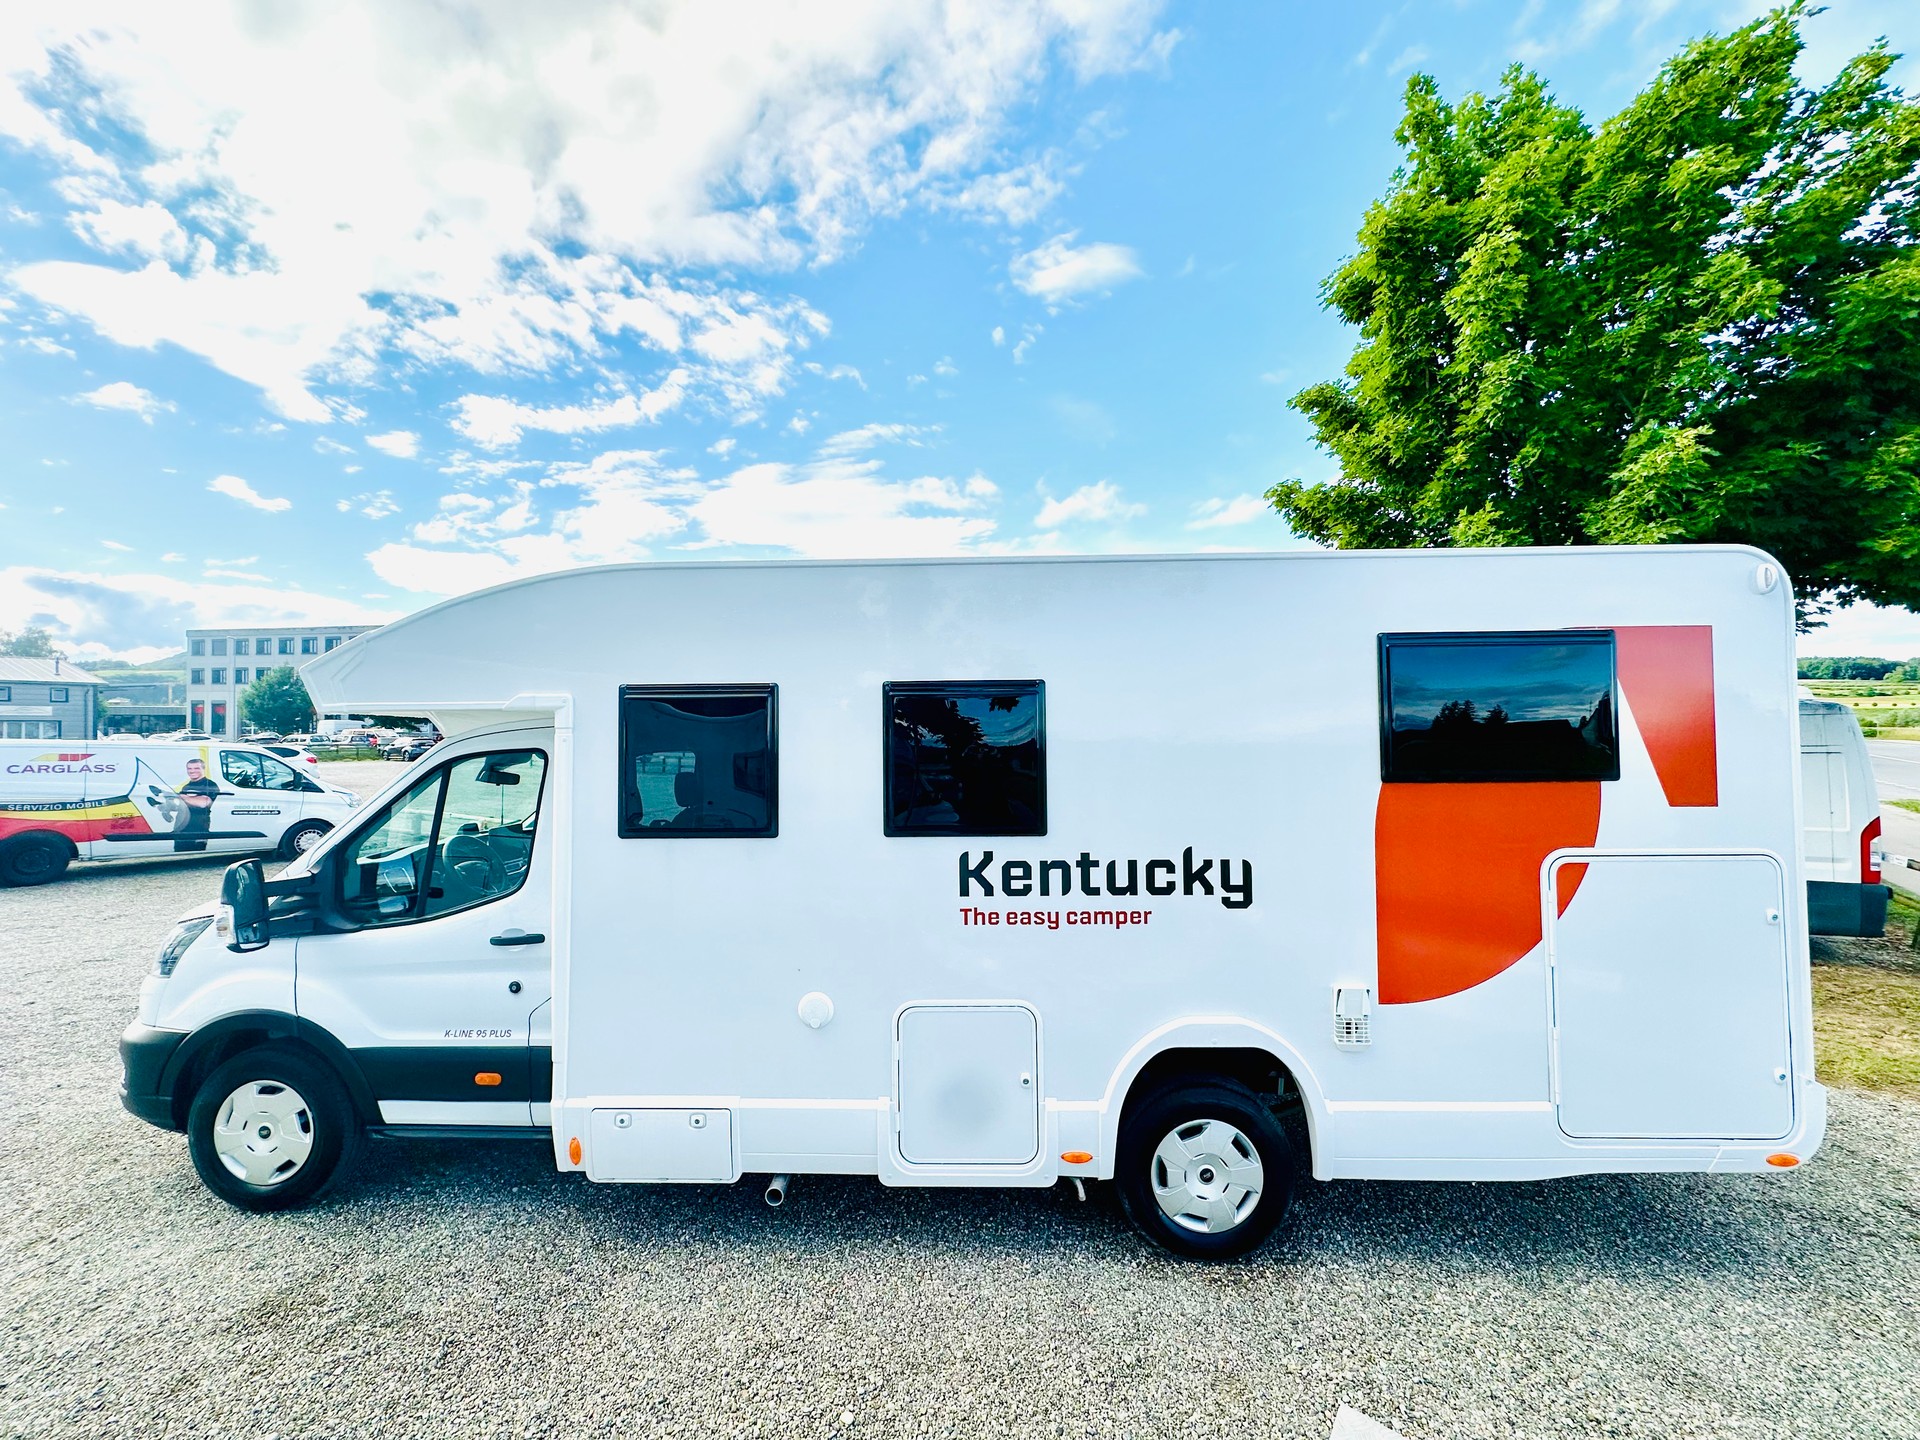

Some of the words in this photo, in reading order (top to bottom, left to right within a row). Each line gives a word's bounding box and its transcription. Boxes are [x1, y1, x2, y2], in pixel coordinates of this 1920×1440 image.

[6, 764, 117, 774] CARGLASS
[7, 803, 63, 811] SERVIZIO
[66, 800, 109, 810] MOBILE
[959, 846, 1253, 909] Kentucky
[960, 908, 1000, 926] The
[1006, 909, 1060, 930] easy
[1066, 909, 1153, 930] camper
[444, 1029, 474, 1038] K-LINE
[476, 1029, 487, 1038] 95
[489, 1029, 512, 1038] PLUS
